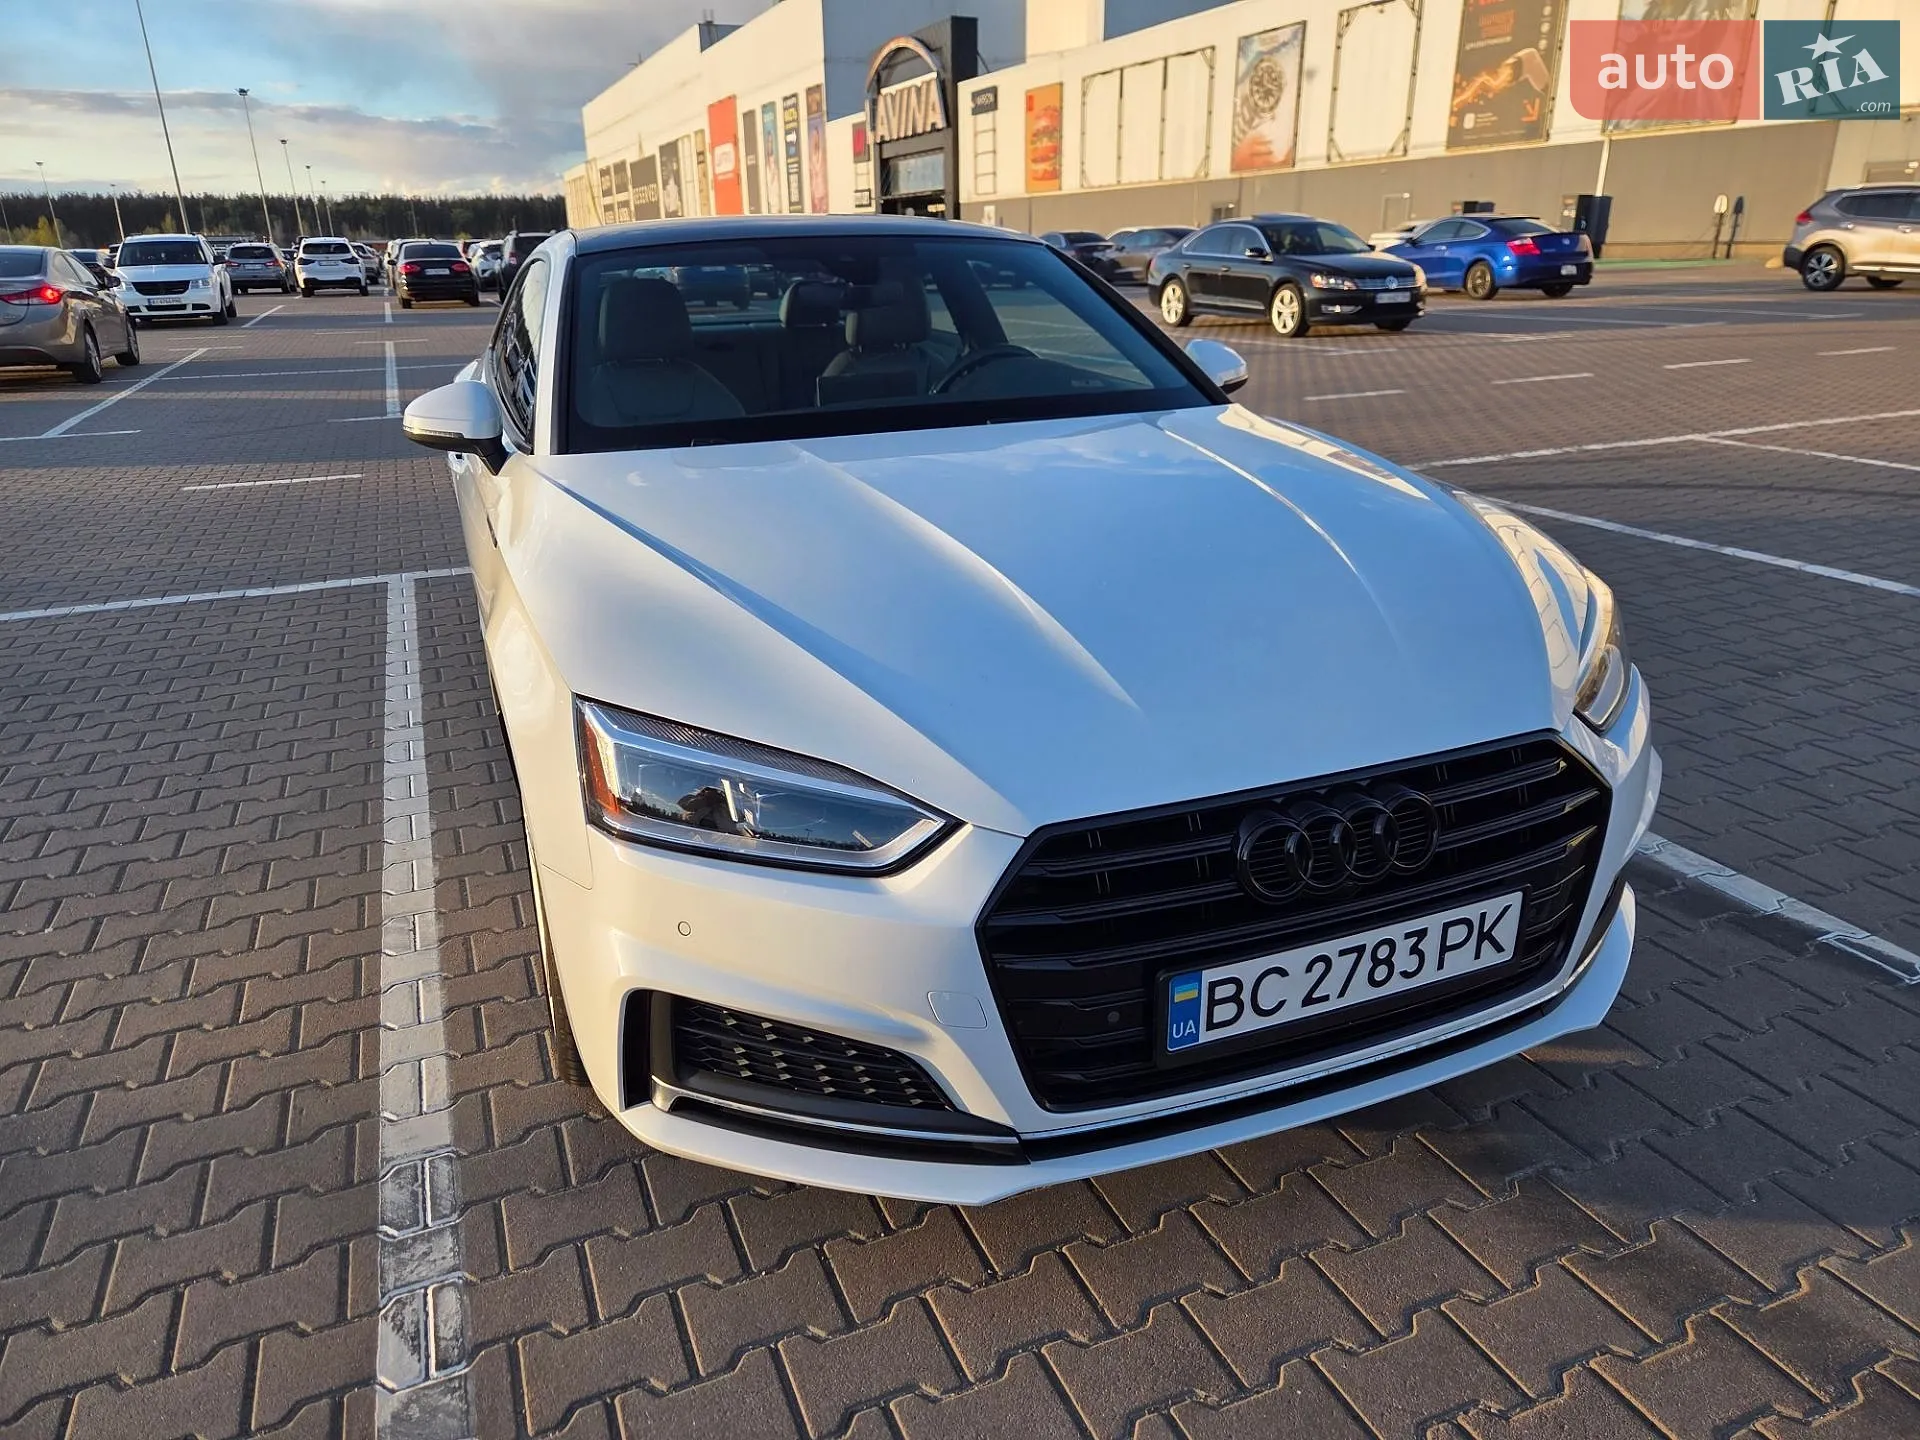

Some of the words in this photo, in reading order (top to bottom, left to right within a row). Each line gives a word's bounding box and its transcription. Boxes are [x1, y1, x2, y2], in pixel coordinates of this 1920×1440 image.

[1206, 966, 1290, 1032] BC
[1301, 926, 1429, 1008] 2783
[1437, 903, 1513, 972] PK
[1172, 1019, 1196, 1038] UA
